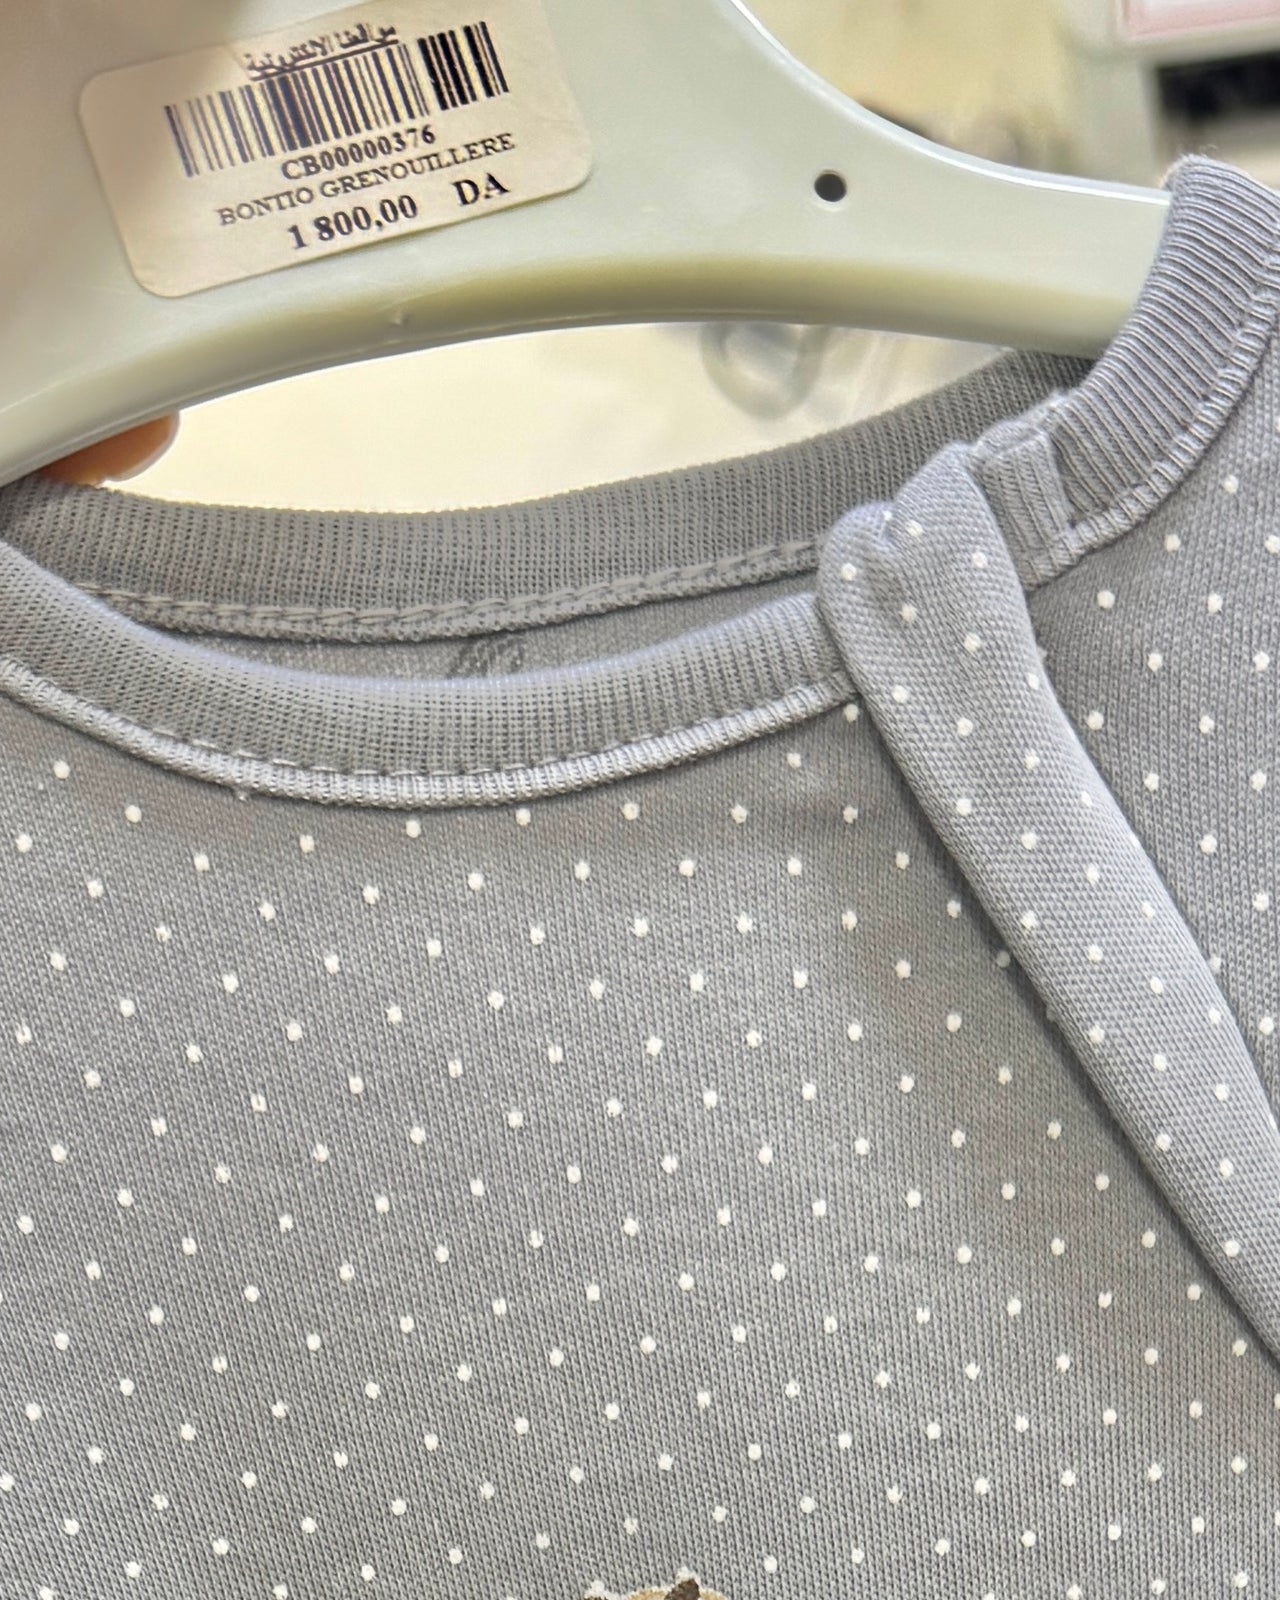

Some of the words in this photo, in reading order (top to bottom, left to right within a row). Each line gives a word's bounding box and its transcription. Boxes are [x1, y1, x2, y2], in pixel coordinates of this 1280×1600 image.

[216, 187, 315, 227] BONTIO
[320, 132, 516, 199] GRENOUILLERE
[281, 124, 436, 180] CB00000376
[451, 172, 511, 207] DA
